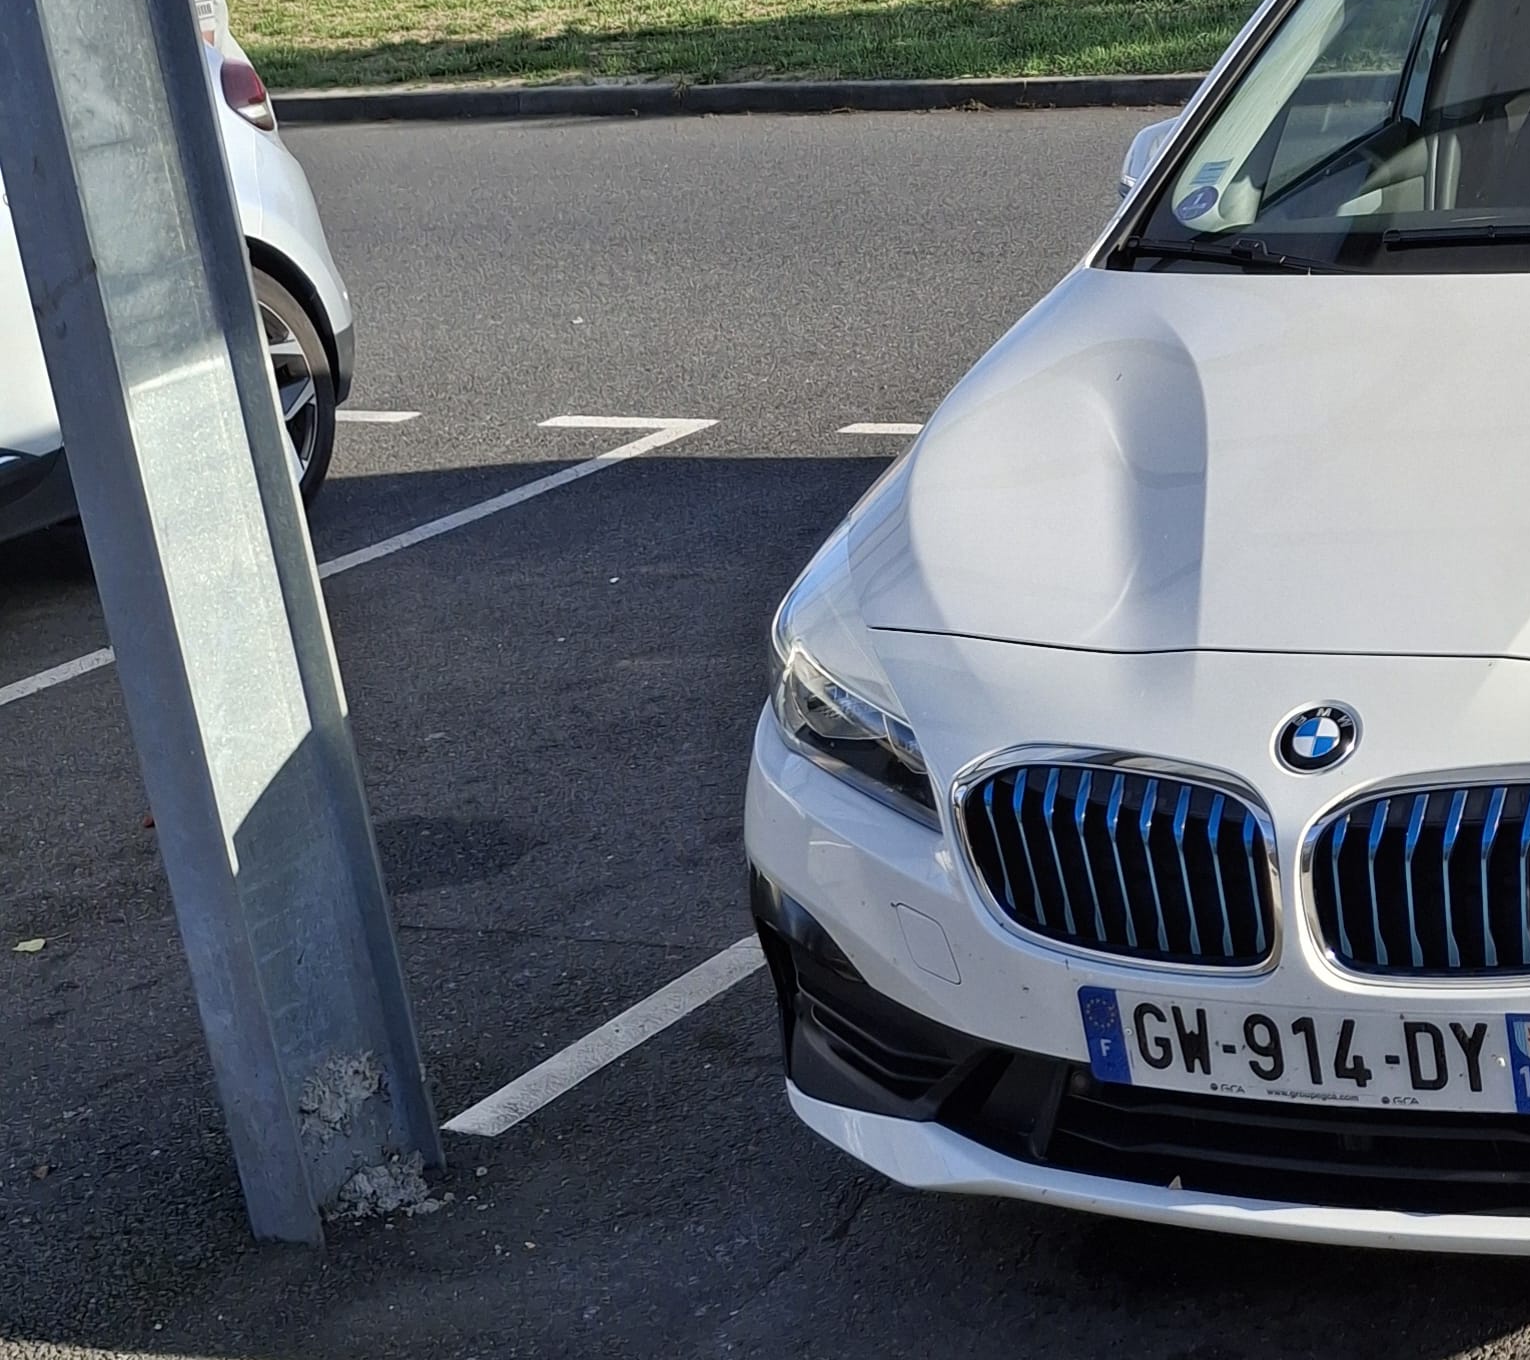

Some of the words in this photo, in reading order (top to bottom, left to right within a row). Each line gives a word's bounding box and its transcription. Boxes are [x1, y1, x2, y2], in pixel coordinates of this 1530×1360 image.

[1293, 707, 1352, 728] BMW
[1101, 1039, 1112, 1056] F
[1133, 1002, 1488, 1092] GW-914-DY
